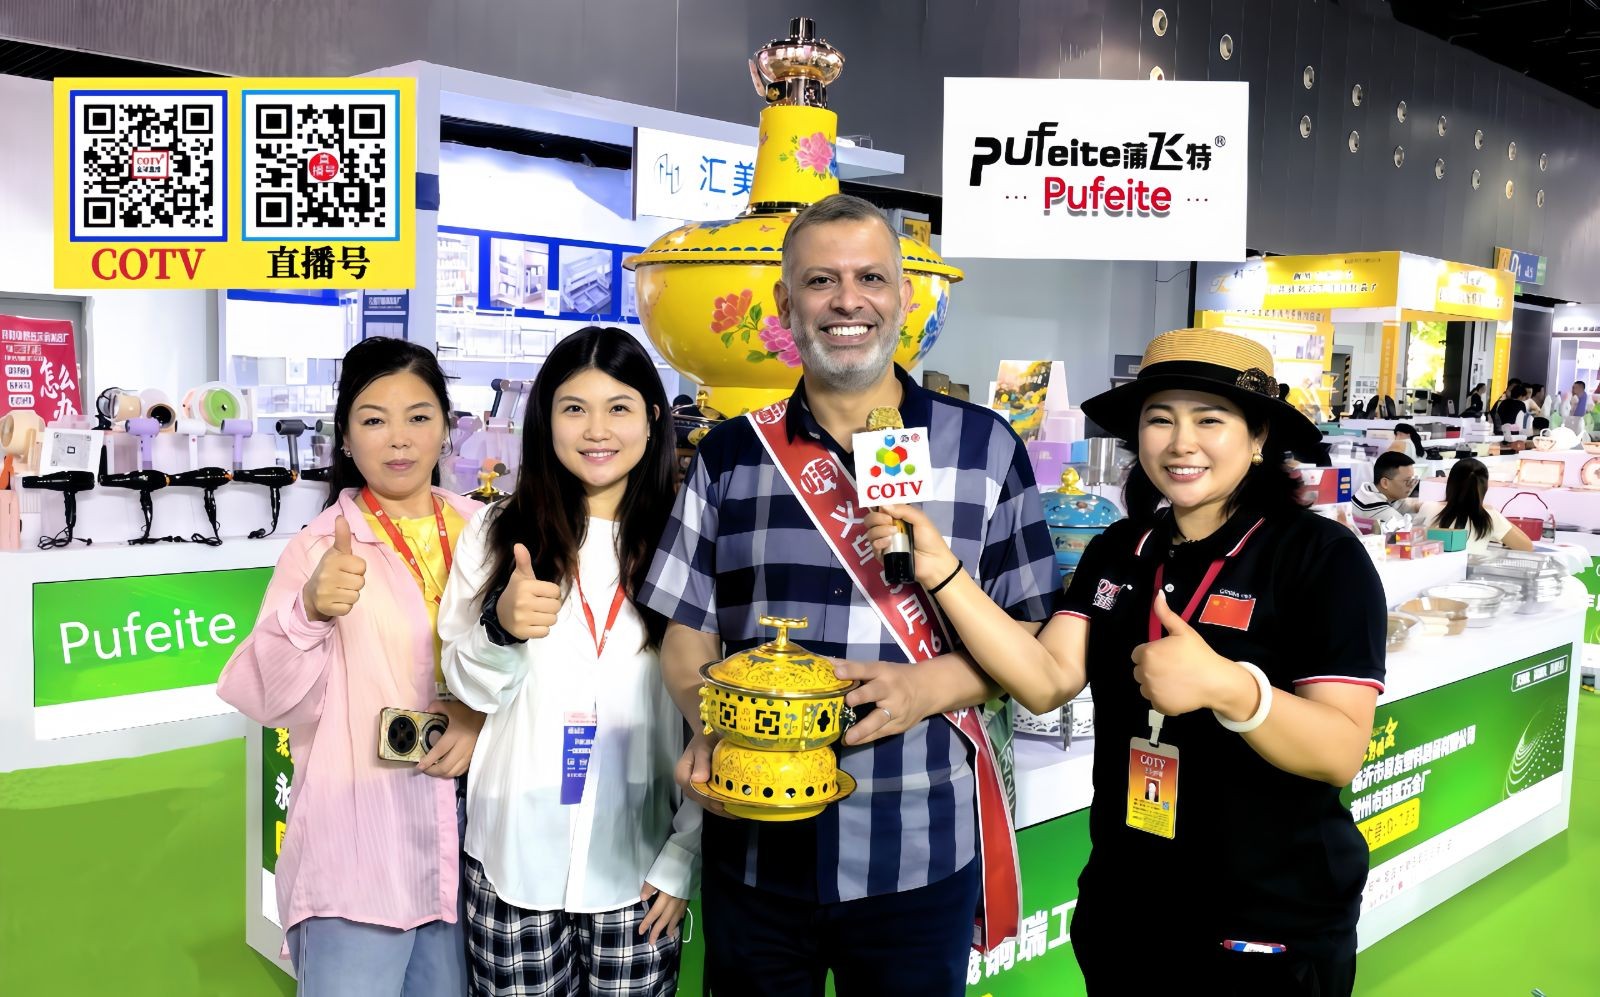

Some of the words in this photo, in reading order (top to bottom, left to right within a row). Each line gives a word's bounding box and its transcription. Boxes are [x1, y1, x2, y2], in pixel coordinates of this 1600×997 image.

[700, 155, 755, 196] 汇美
[1044, 175, 1172, 212] Pufeite
[866, 480, 924, 501] COTV
[59, 608, 237, 665] Pufeite
